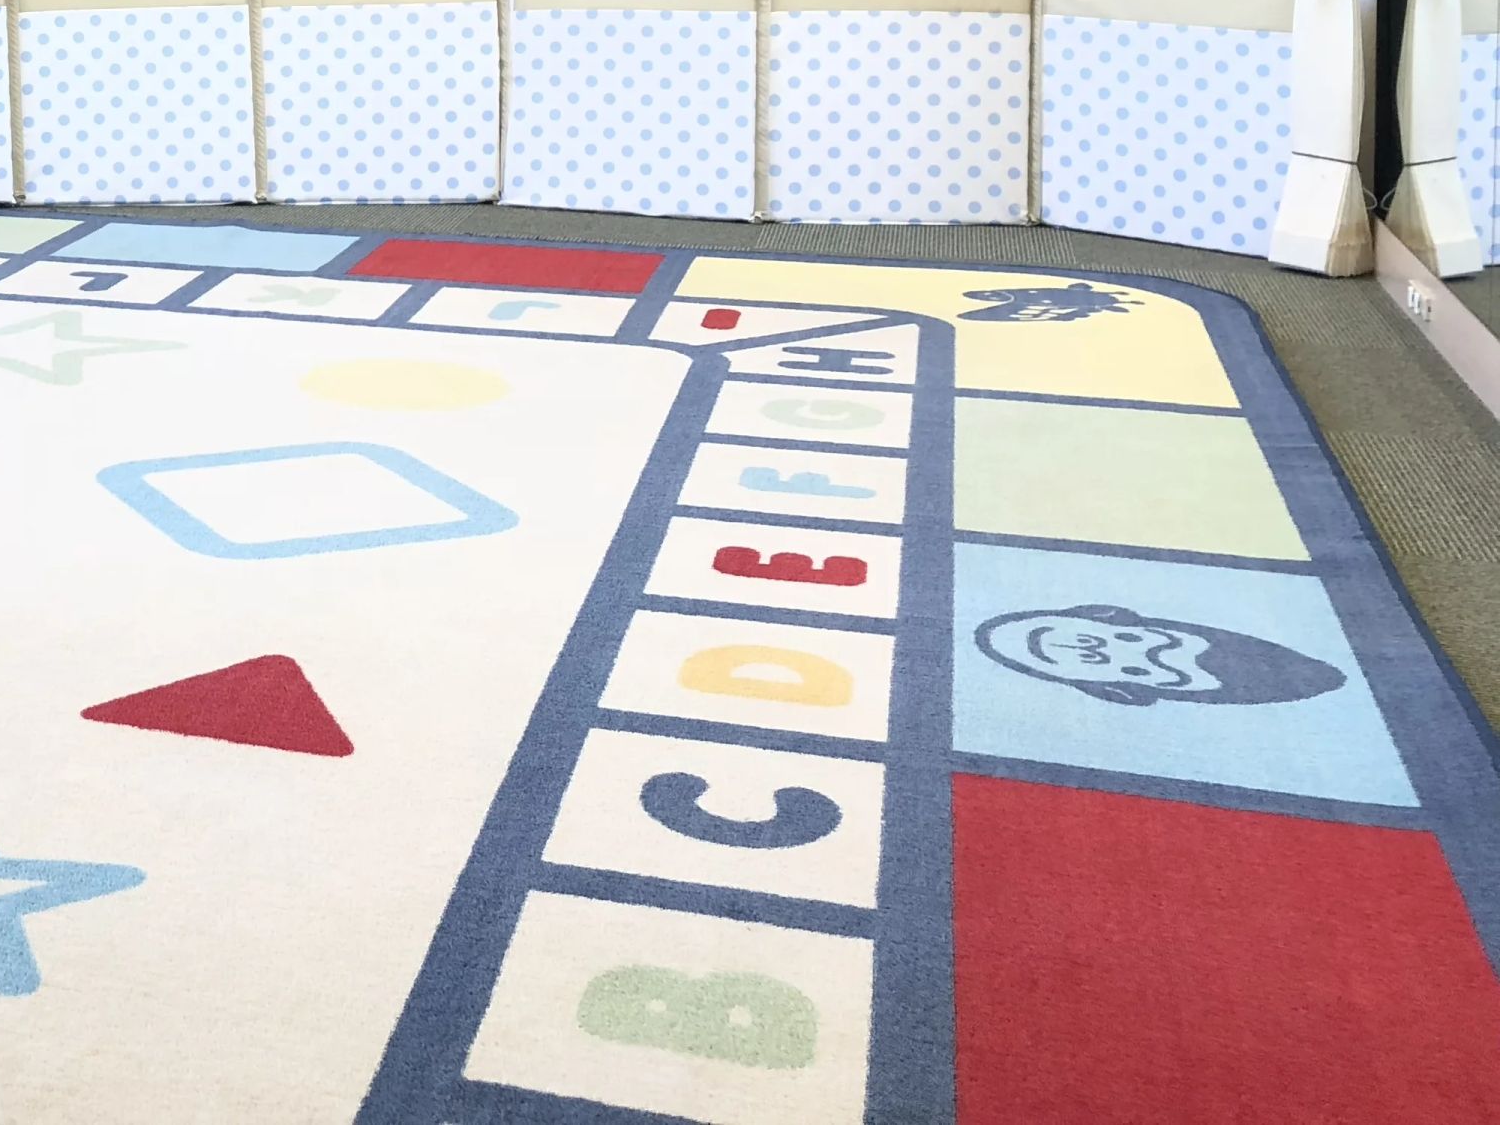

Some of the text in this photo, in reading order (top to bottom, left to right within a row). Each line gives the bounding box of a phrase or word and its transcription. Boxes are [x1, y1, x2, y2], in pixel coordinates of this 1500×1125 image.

[248, 285, 342, 308] K
[489, 301, 562, 321] J
[577, 348, 896, 1072] B C D E F G H
